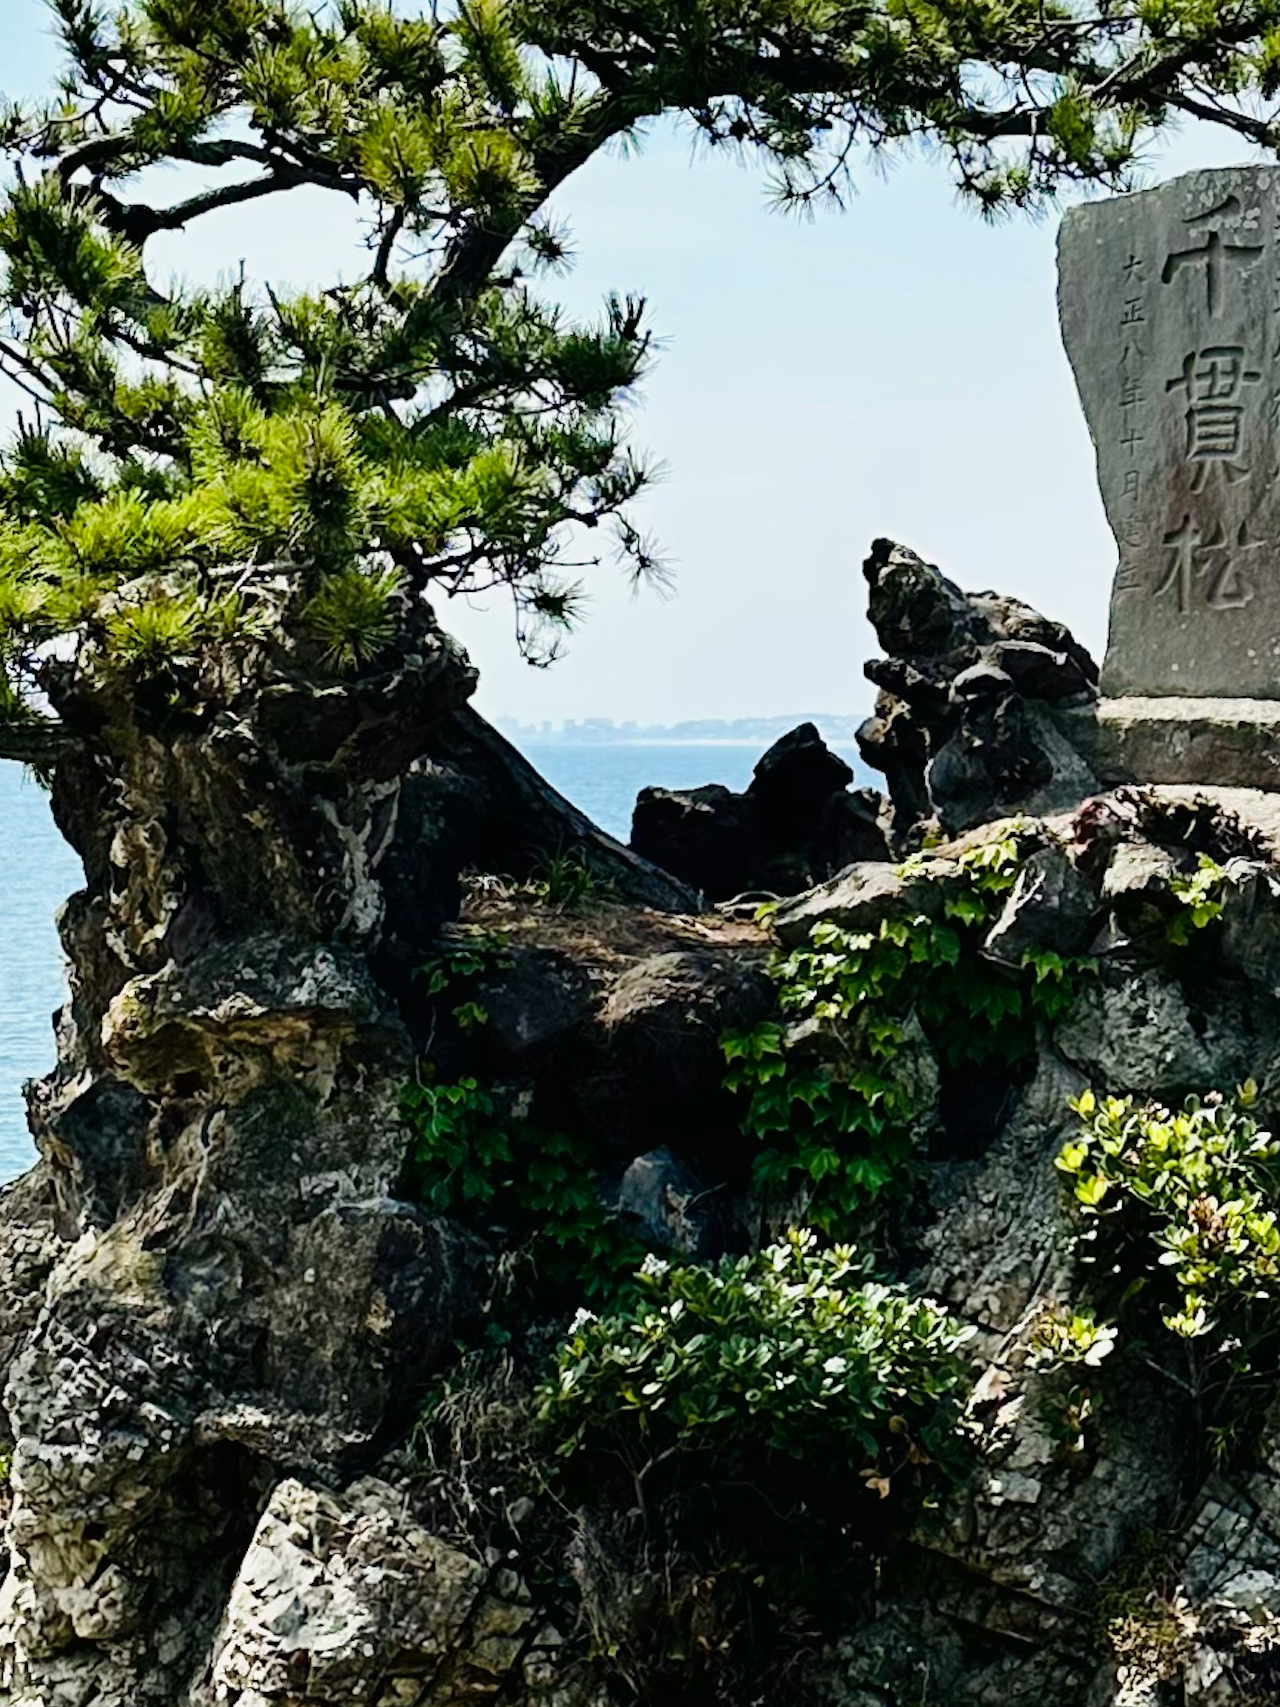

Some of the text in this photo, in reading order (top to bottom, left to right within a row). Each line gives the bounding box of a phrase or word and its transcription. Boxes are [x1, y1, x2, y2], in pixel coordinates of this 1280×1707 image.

[1118, 254, 1147, 589] 大正八年十月建立
[1153, 195, 1265, 615] 千貫松
